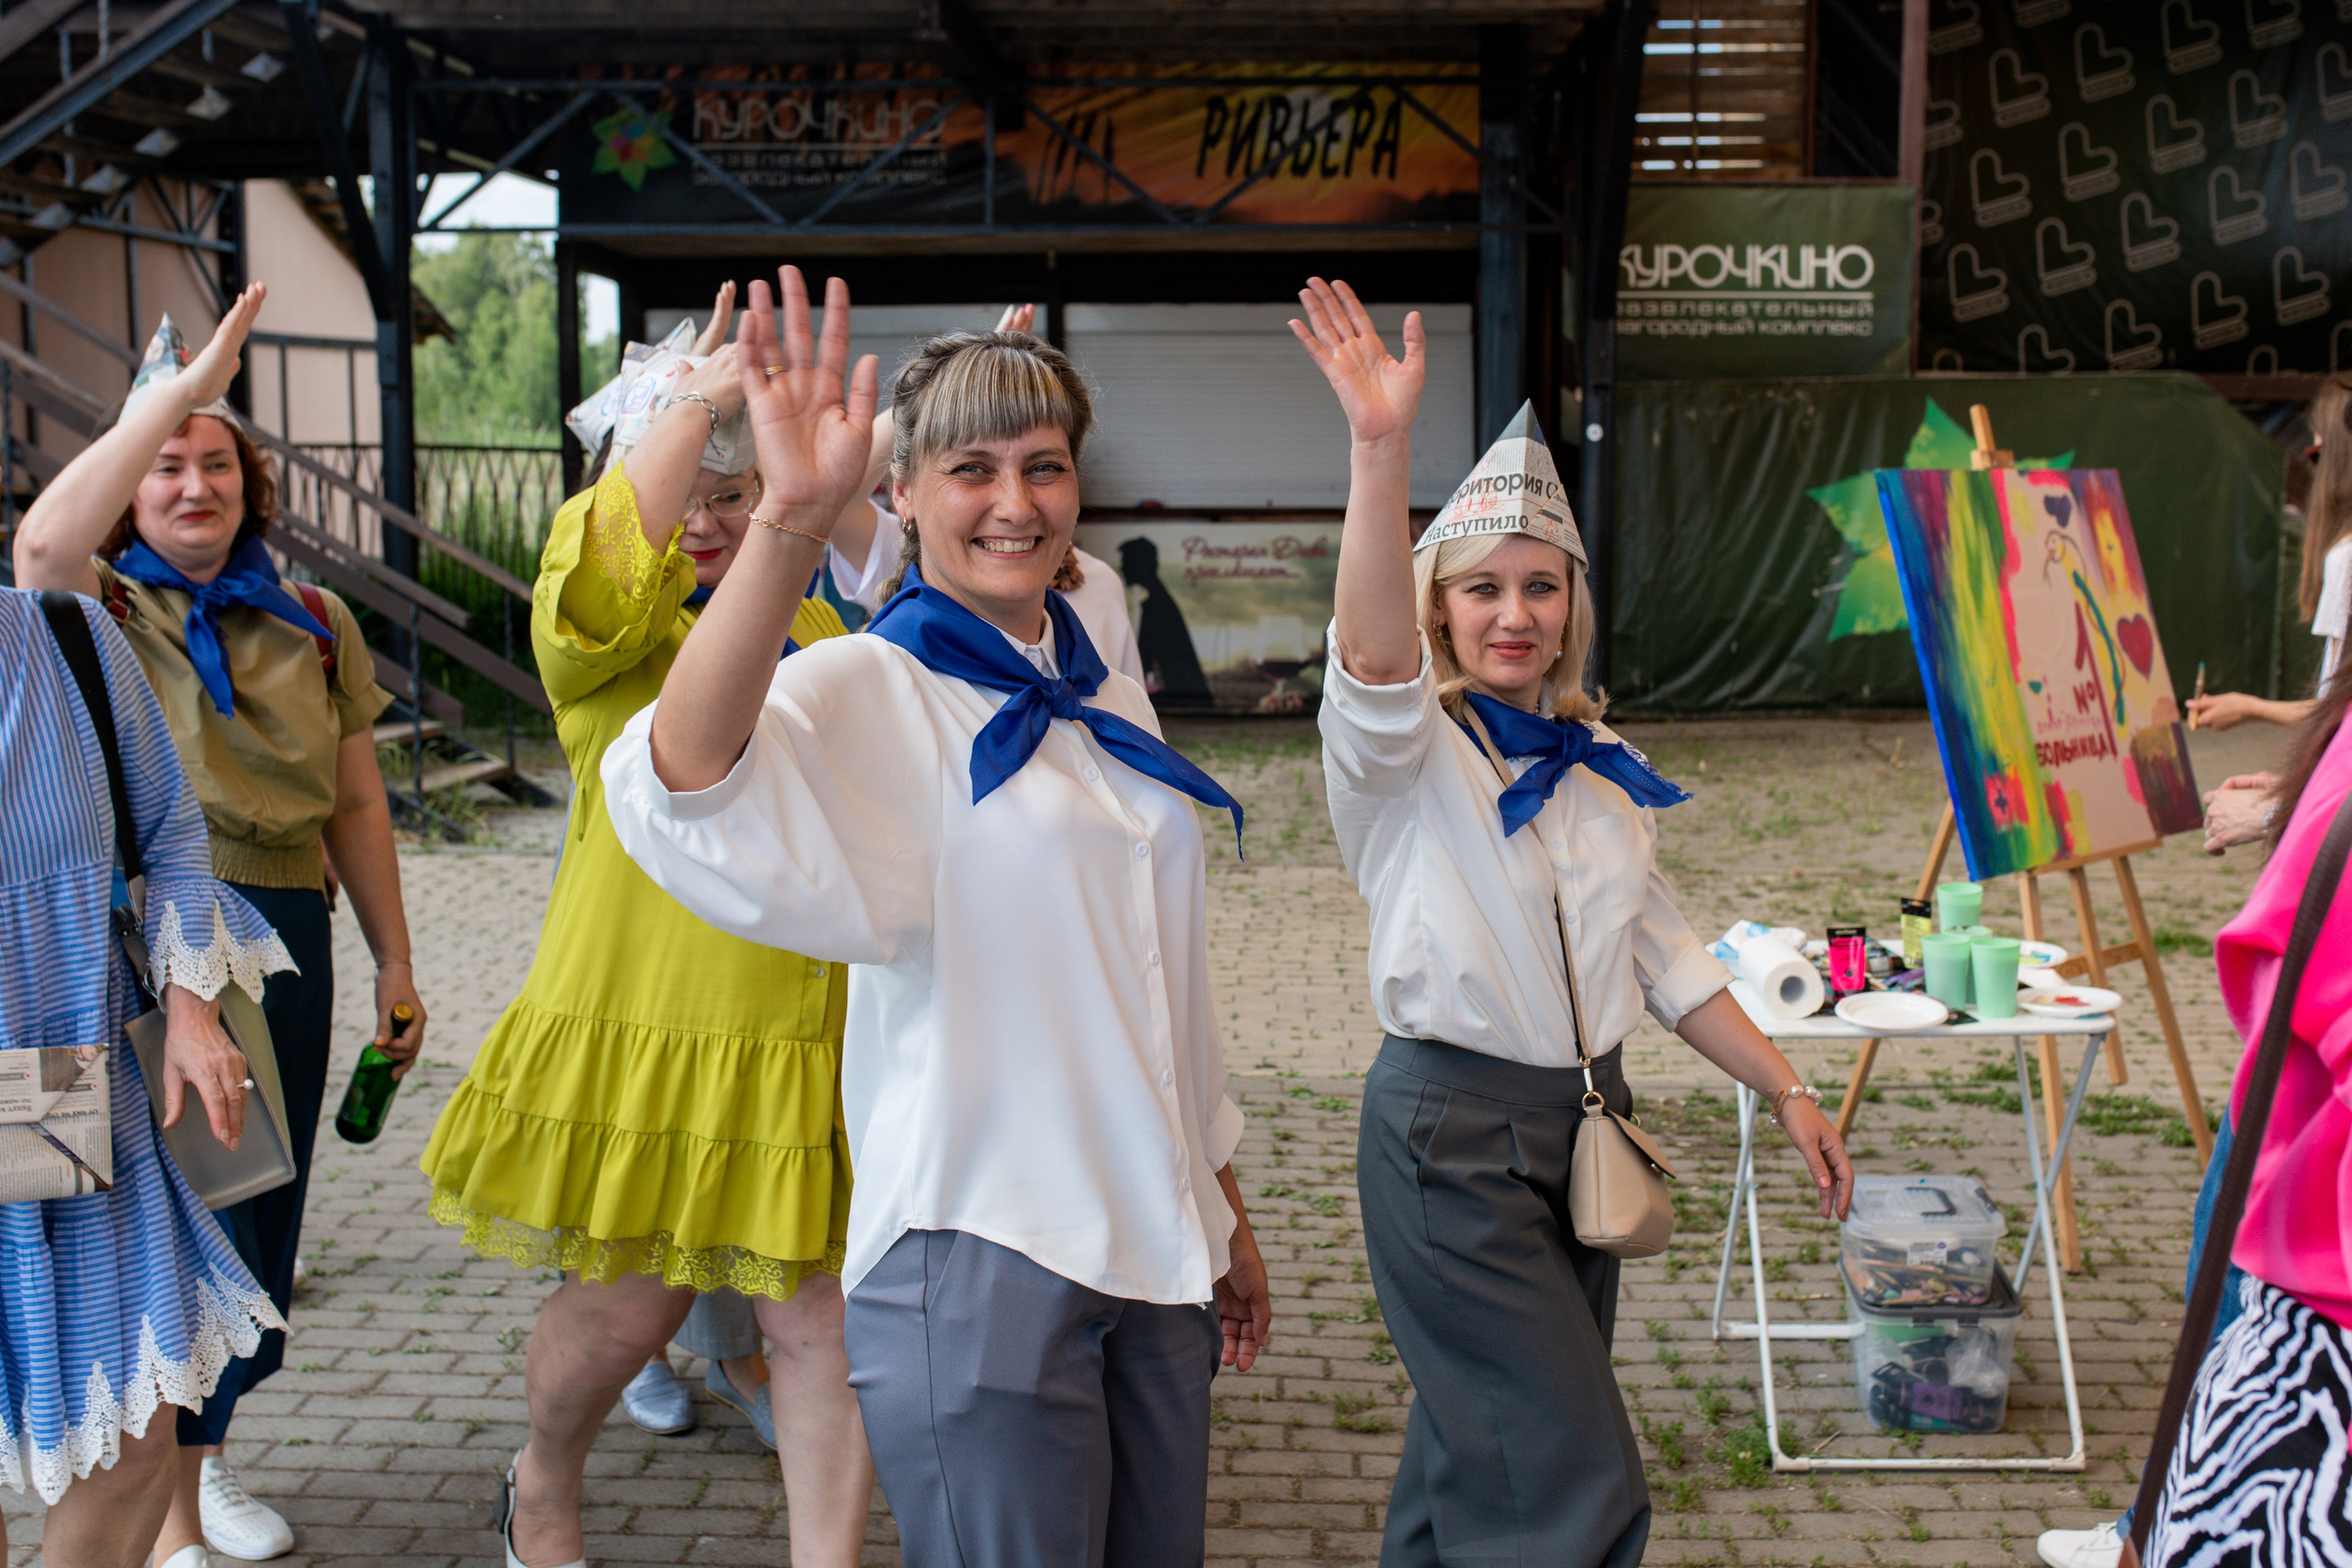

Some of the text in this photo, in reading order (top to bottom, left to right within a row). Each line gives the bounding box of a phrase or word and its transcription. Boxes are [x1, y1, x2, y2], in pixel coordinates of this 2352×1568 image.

[693, 98, 945, 141] КУРОЧКИНО
[1196, 96, 1402, 180] РИВЬЕРА
[692, 152, 948, 169] азвлекателный
[1619, 243, 1876, 289] КУРОЧКИНО
[1421, 514, 1529, 545] Наступило
